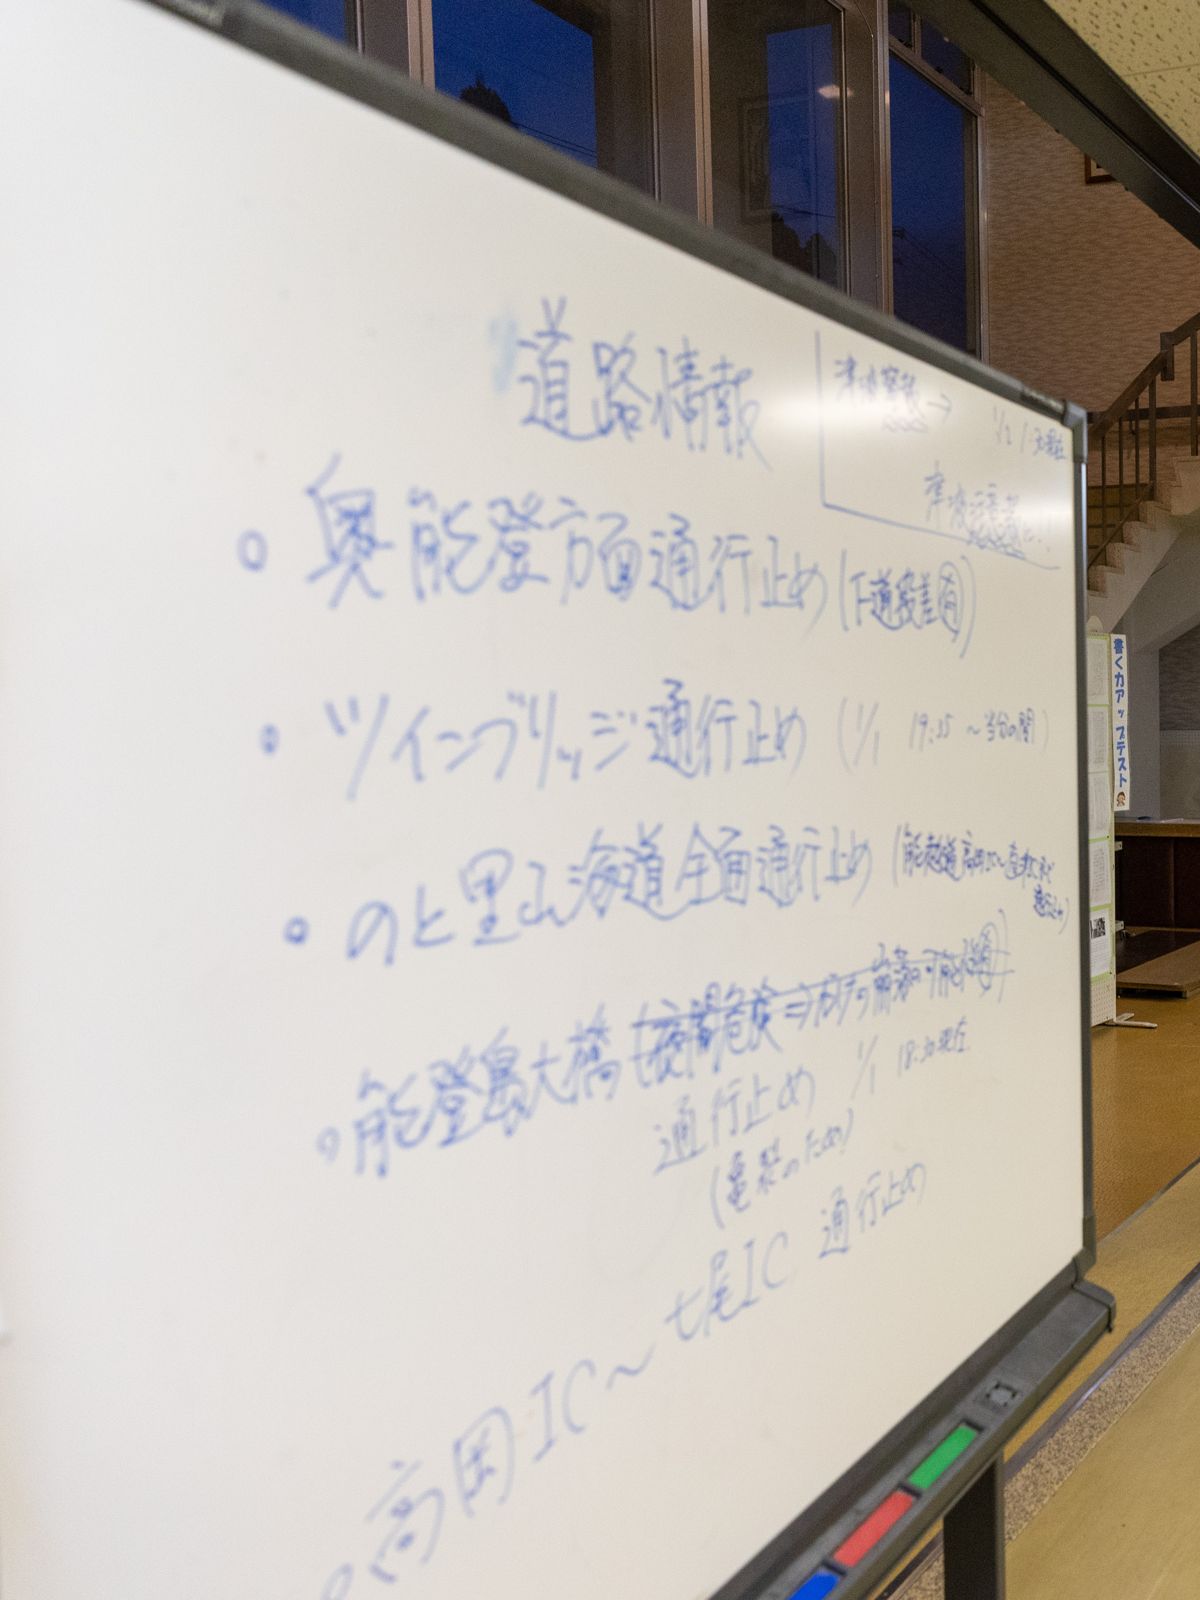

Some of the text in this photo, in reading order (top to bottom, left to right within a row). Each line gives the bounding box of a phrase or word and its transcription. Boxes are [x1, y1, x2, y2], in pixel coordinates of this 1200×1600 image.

[516, 297, 772, 471] 道路情報
[1113, 637, 1128, 788] 書く力アップテスト
[653, 1064, 816, 1176] 通行止め
[817, 1160, 927, 1260] 通行止め
